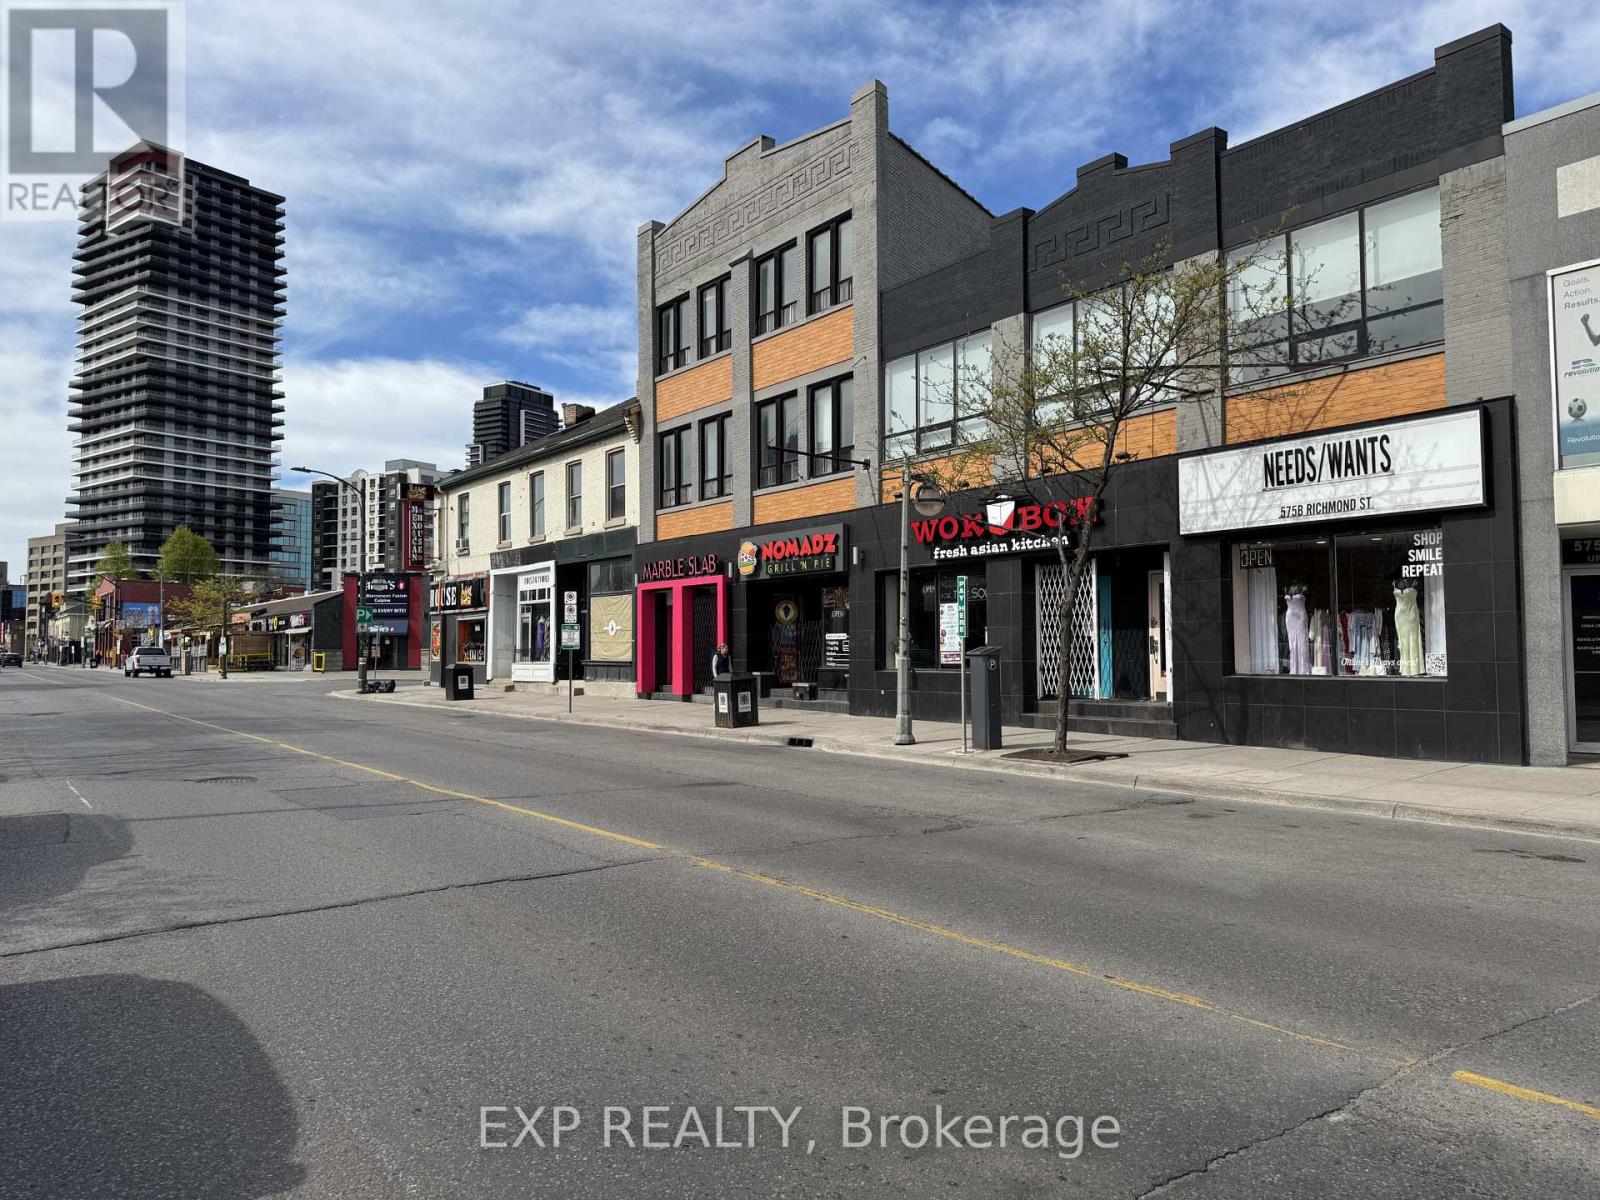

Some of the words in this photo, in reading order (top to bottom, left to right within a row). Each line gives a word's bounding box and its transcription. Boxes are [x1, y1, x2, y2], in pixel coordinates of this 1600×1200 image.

[1563, 276, 1591, 288] Goals.
[1564, 287, 1592, 299] Action.
[1564, 297, 1600, 310] Results.
[1263, 434, 1392, 488] NEEDS/WANTS
[1280, 504, 1303, 519] 575B
[1306, 498, 1357, 516] RICHMOND
[1360, 496, 1372, 510] ST
[911, 513, 985, 545] WOK
[761, 533, 837, 561] NOMADZ
[1413, 532, 1443, 546] SHOP
[933, 545, 969, 560] fresh
[970, 541, 1009, 556] asian
[1240, 549, 1272, 567] OPEN
[1408, 547, 1443, 562] SMILE
[642, 558, 685, 580] MARBLE
[688, 554, 716, 576] SLAB
[767, 562, 796, 574] GRILL
[814, 558, 831, 569] PIE
[1402, 563, 1444, 578] REPEAT
